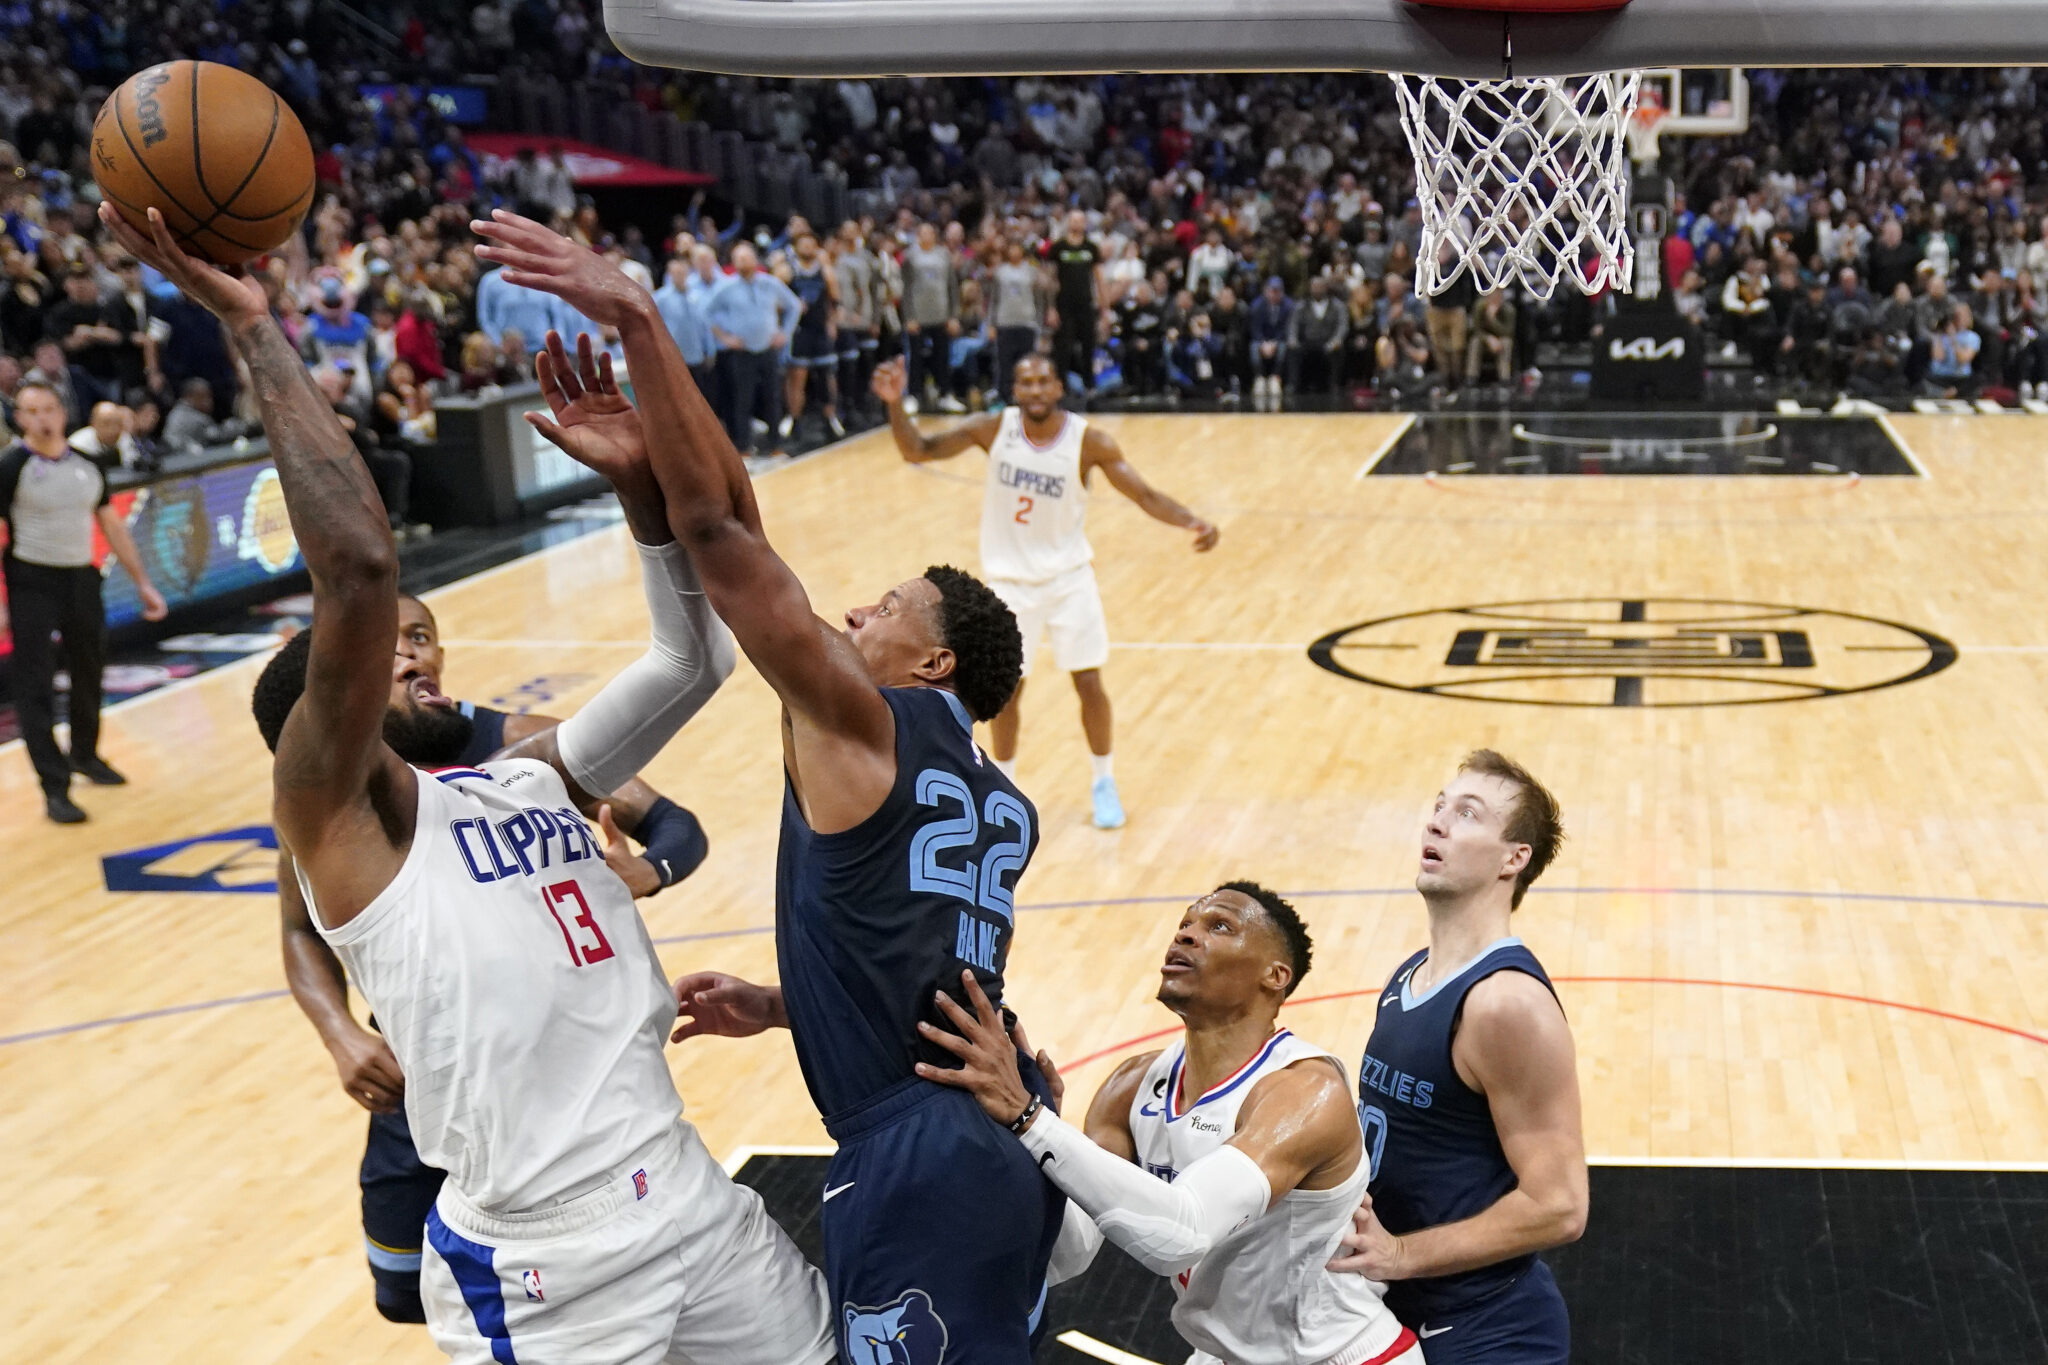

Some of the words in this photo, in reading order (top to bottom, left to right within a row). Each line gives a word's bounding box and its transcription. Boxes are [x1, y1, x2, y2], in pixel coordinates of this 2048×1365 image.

[999, 461, 1066, 499] CLIPPERS
[1014, 495, 1034, 525] 2
[500, 770, 535, 788] oney
[909, 768, 1032, 929] 22
[541, 879, 616, 968] 13
[956, 910, 1002, 975] BANE
[1360, 1054, 1435, 1109] ZZLIES
[1358, 1098, 1388, 1182] 0
